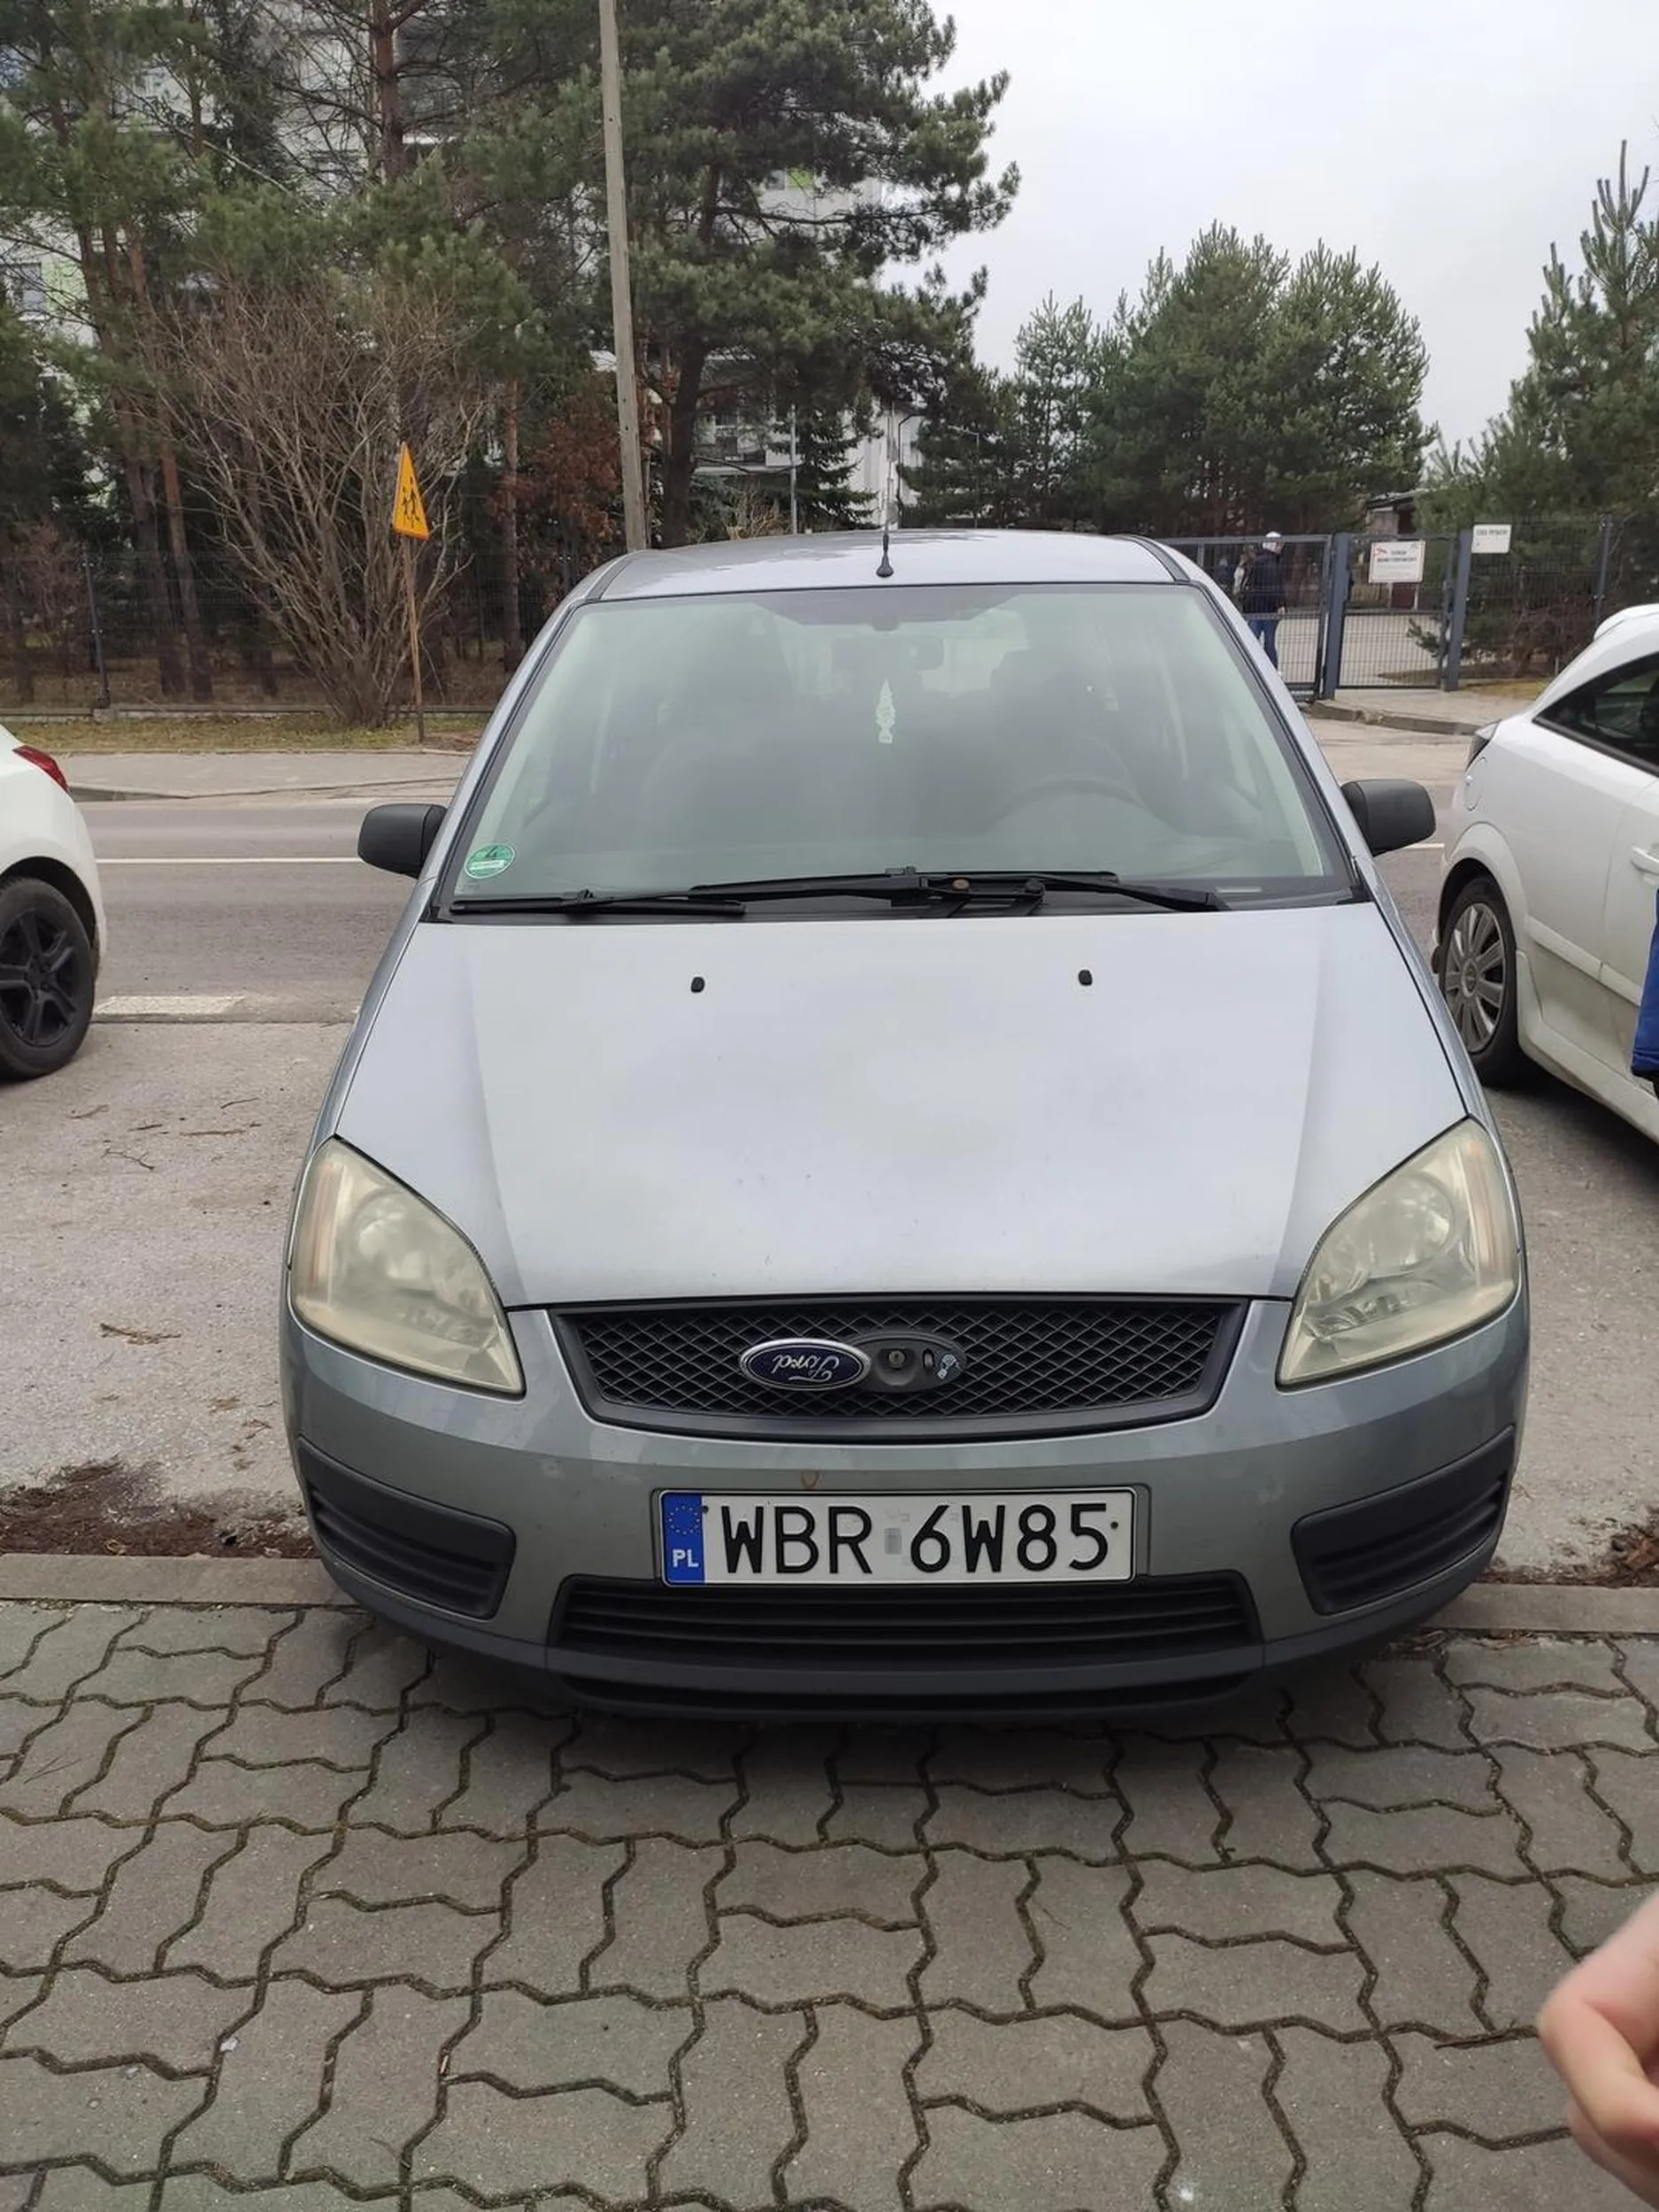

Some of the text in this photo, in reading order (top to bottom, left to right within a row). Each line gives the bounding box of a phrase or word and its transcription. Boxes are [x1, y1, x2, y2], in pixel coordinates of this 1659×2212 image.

[771, 1354, 840, 1382] Ford
[720, 1503, 1109, 1574] WBR 6W85
[672, 1549, 699, 1568] PL
